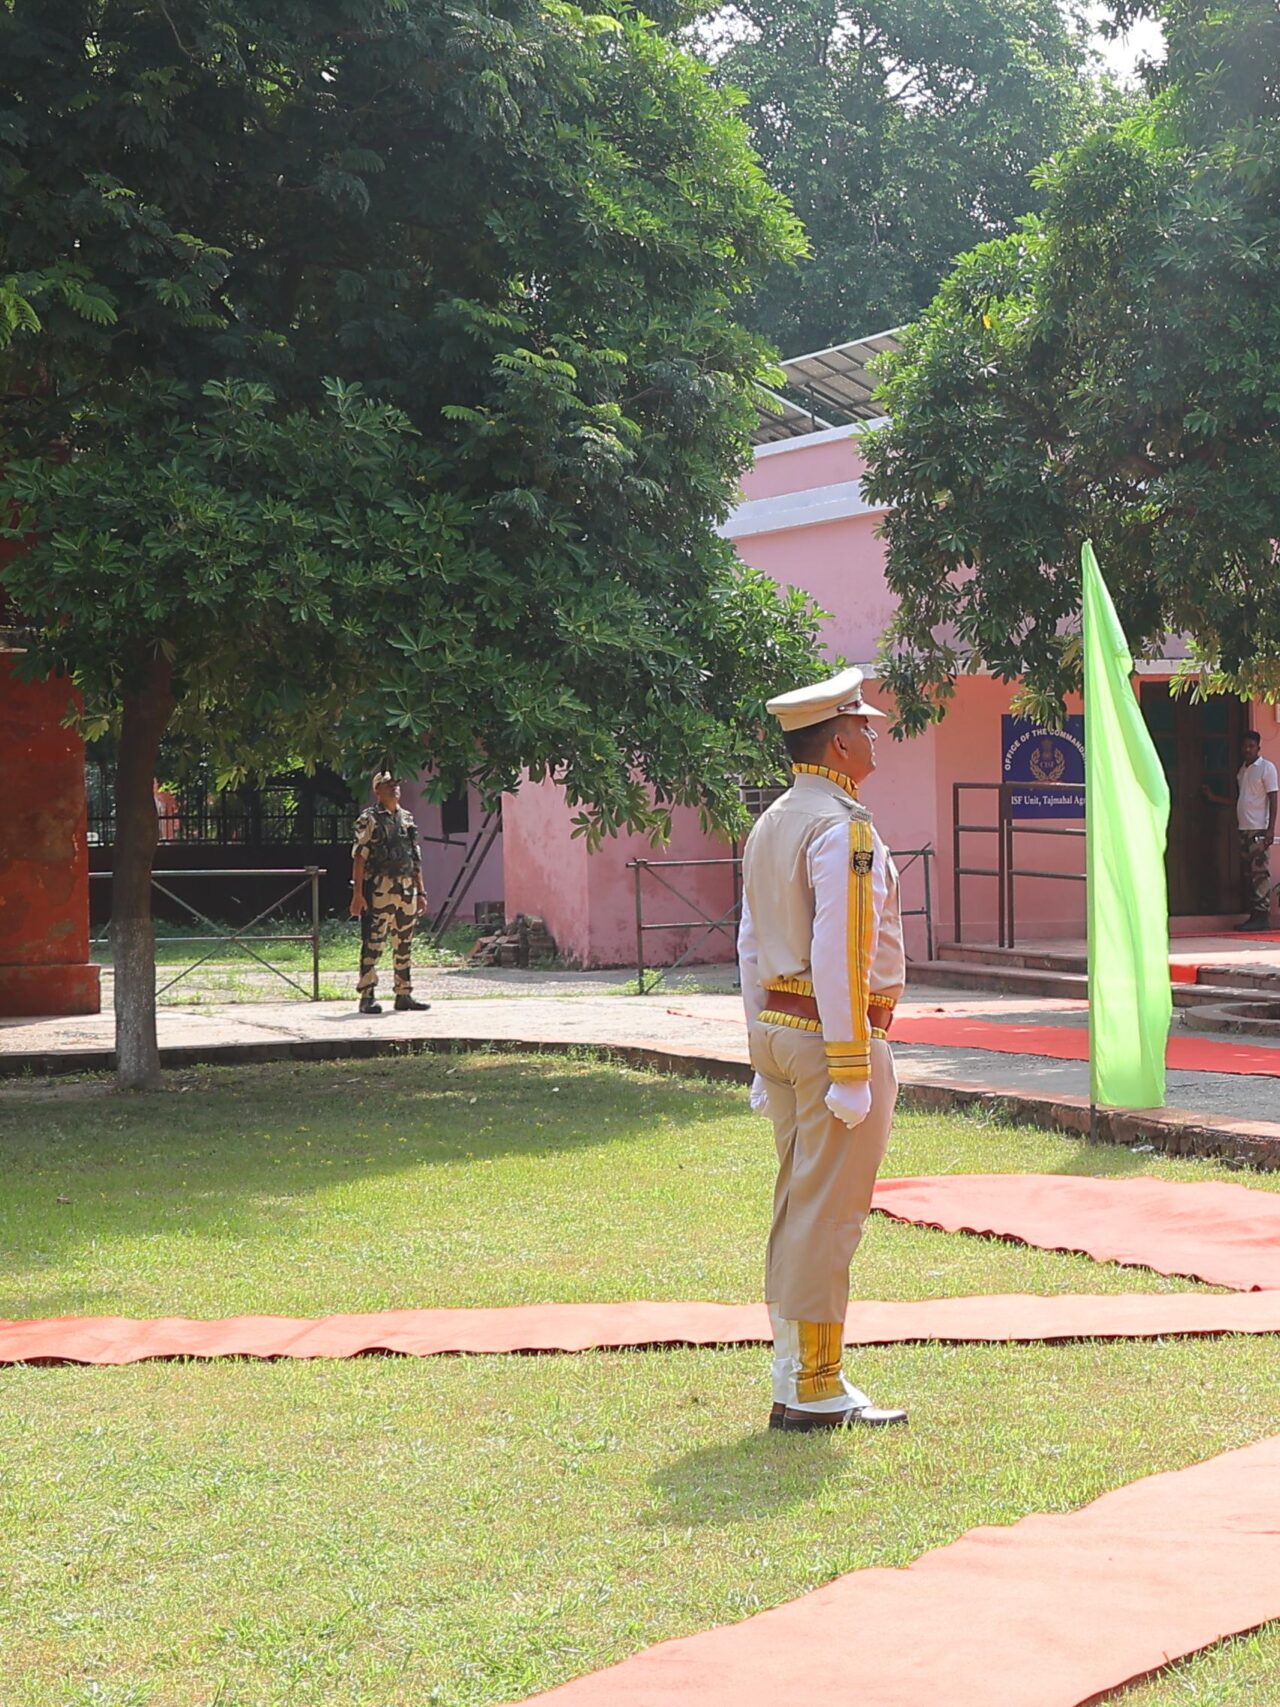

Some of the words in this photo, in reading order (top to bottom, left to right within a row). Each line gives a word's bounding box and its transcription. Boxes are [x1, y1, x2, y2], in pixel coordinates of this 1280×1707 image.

[1004, 740, 1021, 771] OFFICE
[1020, 732, 1031, 742] OF
[1032, 729, 1047, 737] THE
[1011, 796, 1023, 805] ISF
[1024, 796, 1041, 806] Unit,
[1042, 796, 1072, 806] Tajmahal
